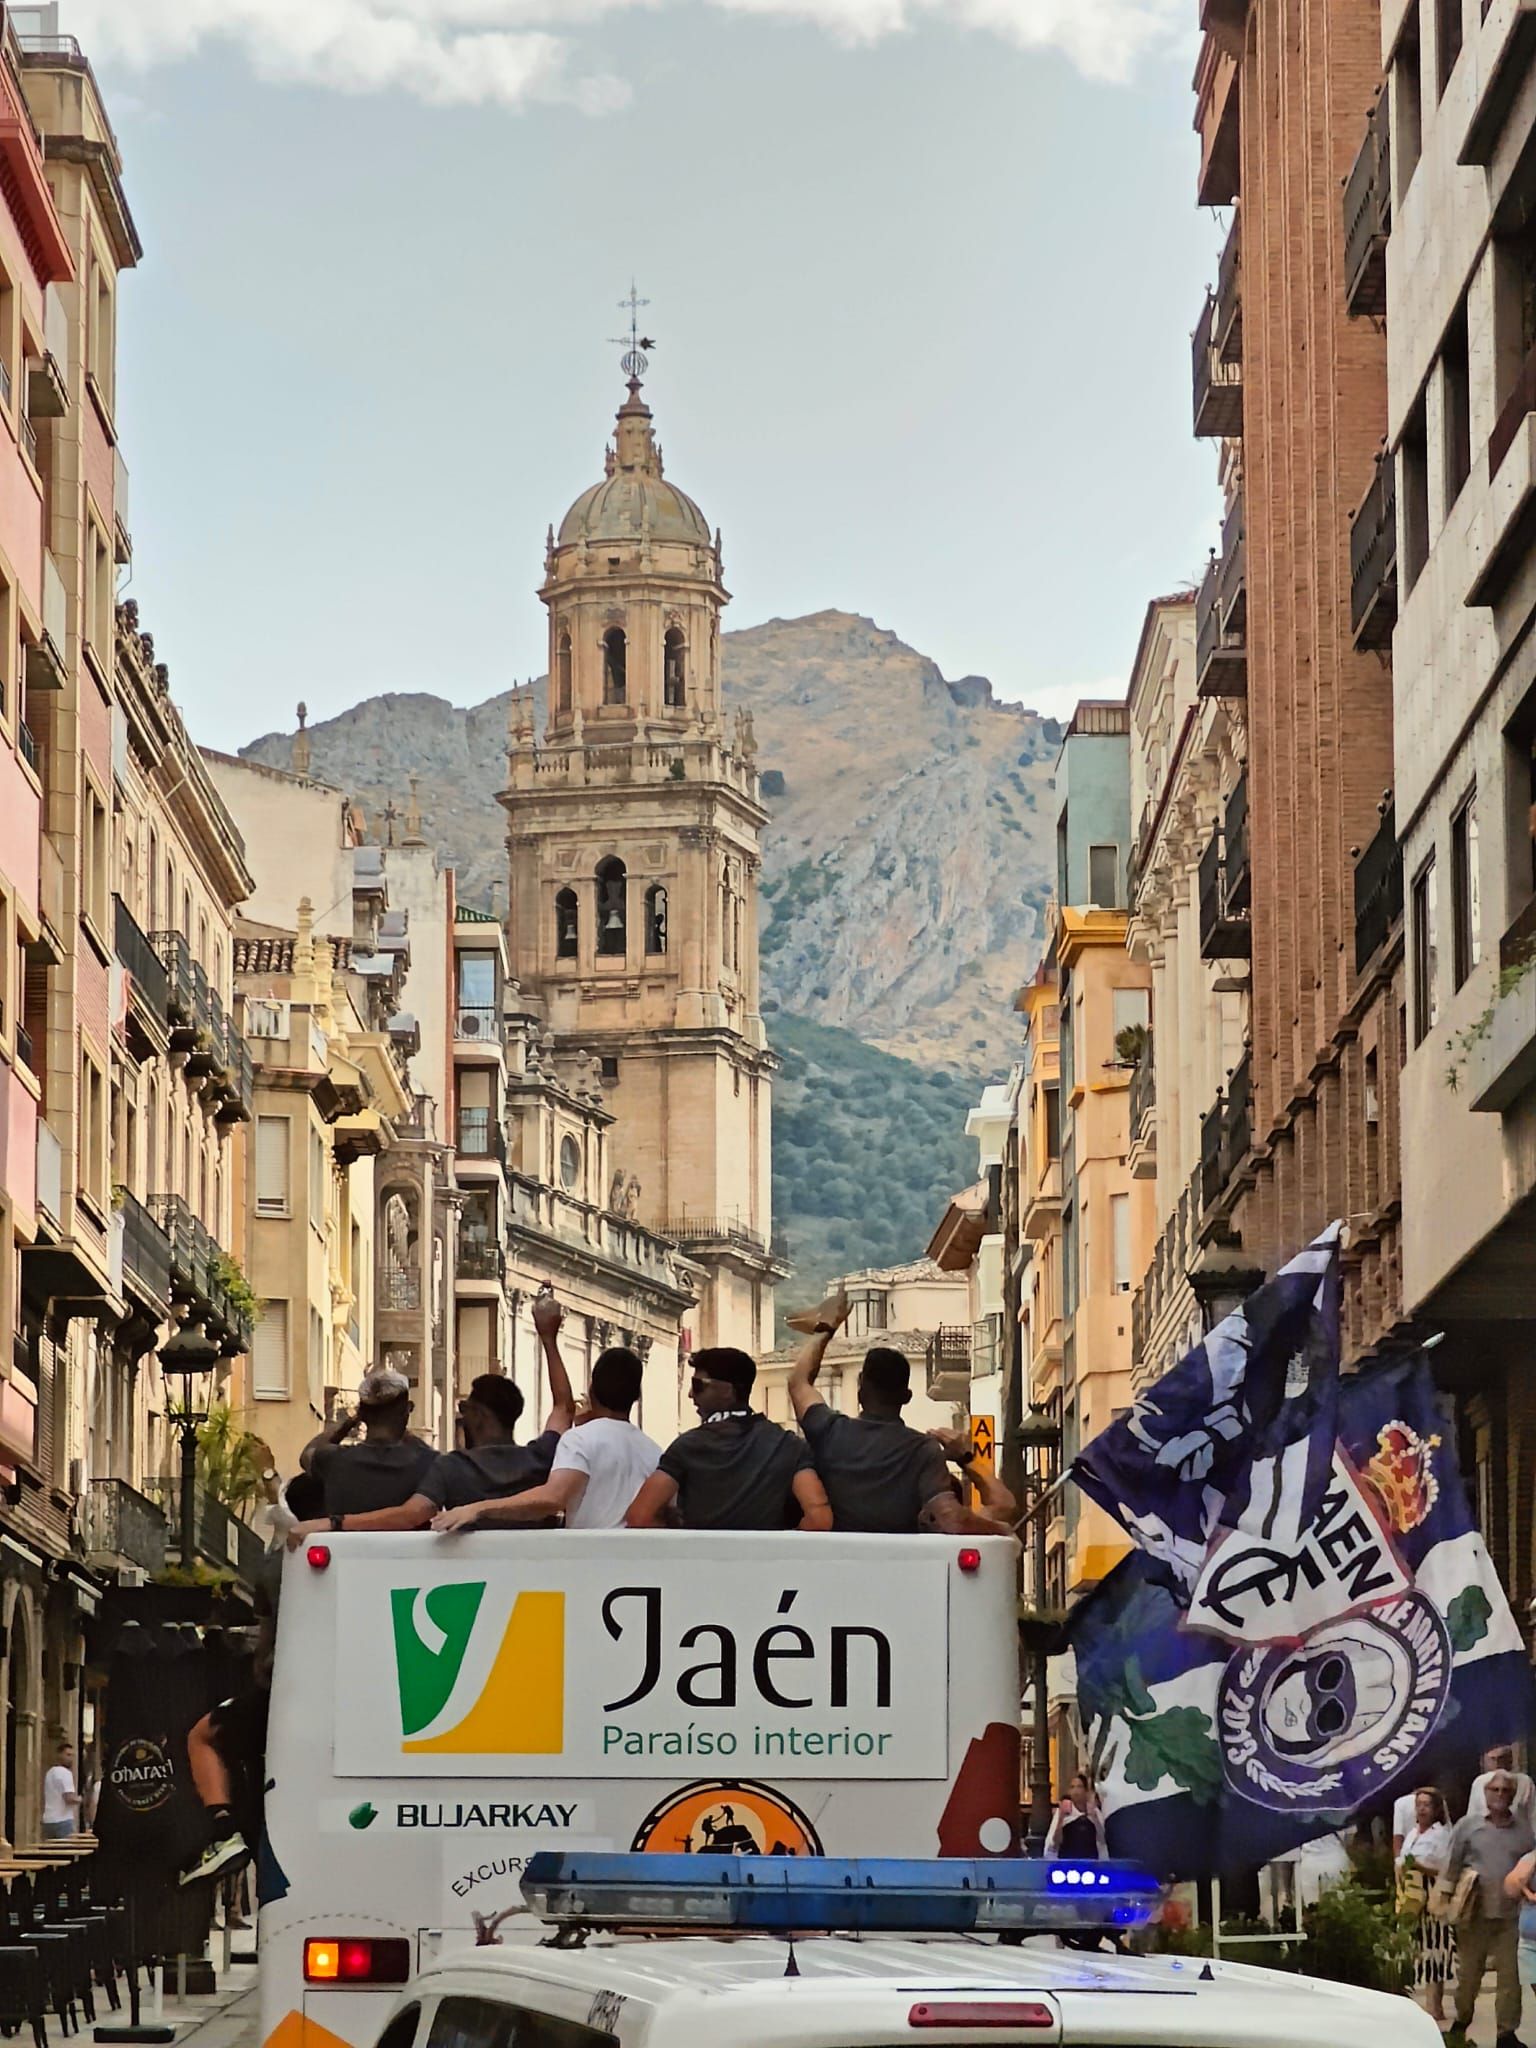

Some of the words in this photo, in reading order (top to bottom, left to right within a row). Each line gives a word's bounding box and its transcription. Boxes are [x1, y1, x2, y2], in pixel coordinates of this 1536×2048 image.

[1312, 1468, 1395, 1601] AEN
[601, 1586, 892, 1713] Jaén
[602, 1722, 737, 1755] Paraíso
[754, 1725, 893, 1755] interior
[1222, 1688, 1258, 1766] 2013
[1372, 1698, 1437, 1772] FANS
[396, 1803, 578, 1828] BUJARKAY
